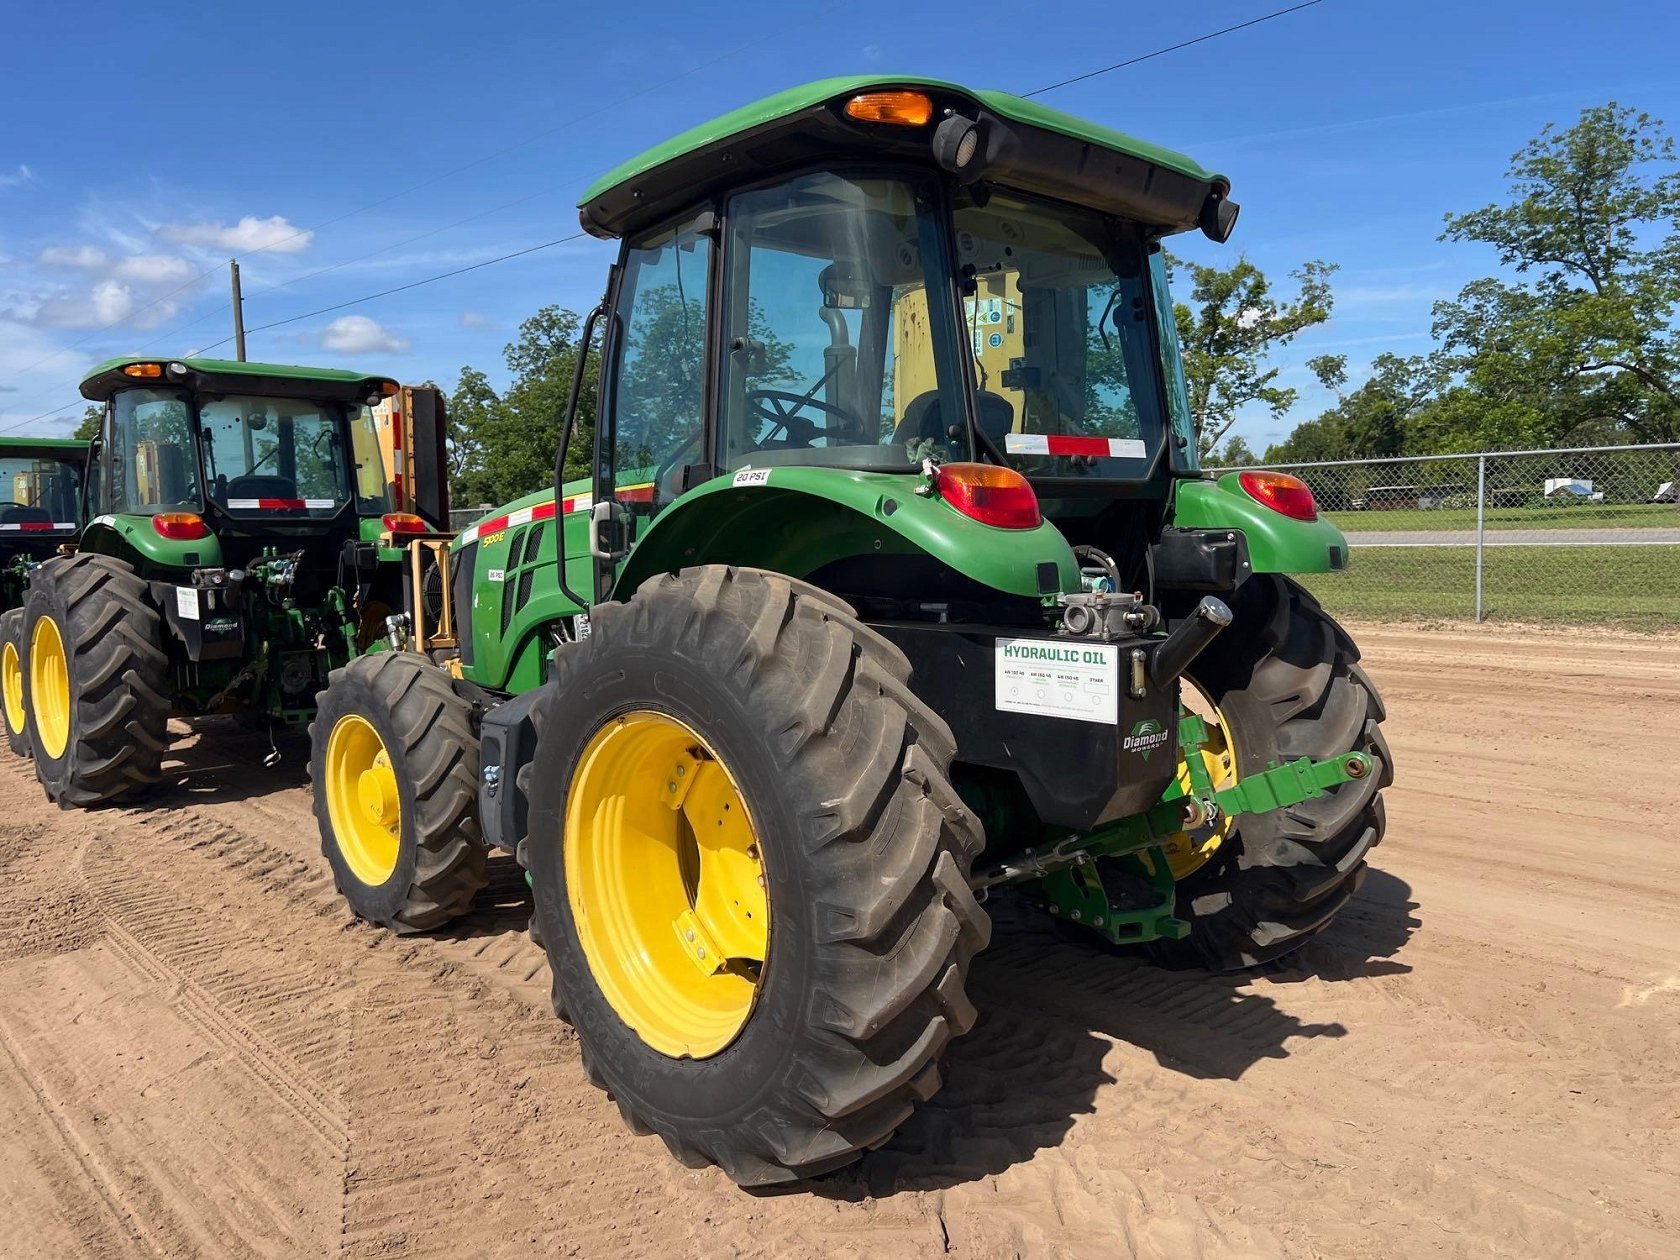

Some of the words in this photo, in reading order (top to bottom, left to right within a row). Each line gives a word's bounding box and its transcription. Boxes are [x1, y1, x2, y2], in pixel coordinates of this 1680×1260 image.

[736, 473, 749, 482] 20
[749, 471, 767, 481] PSI
[1004, 645, 1079, 663] HYDRAULIC
[1083, 651, 1107, 665] OIL
[1123, 729, 1169, 749] Diamond
